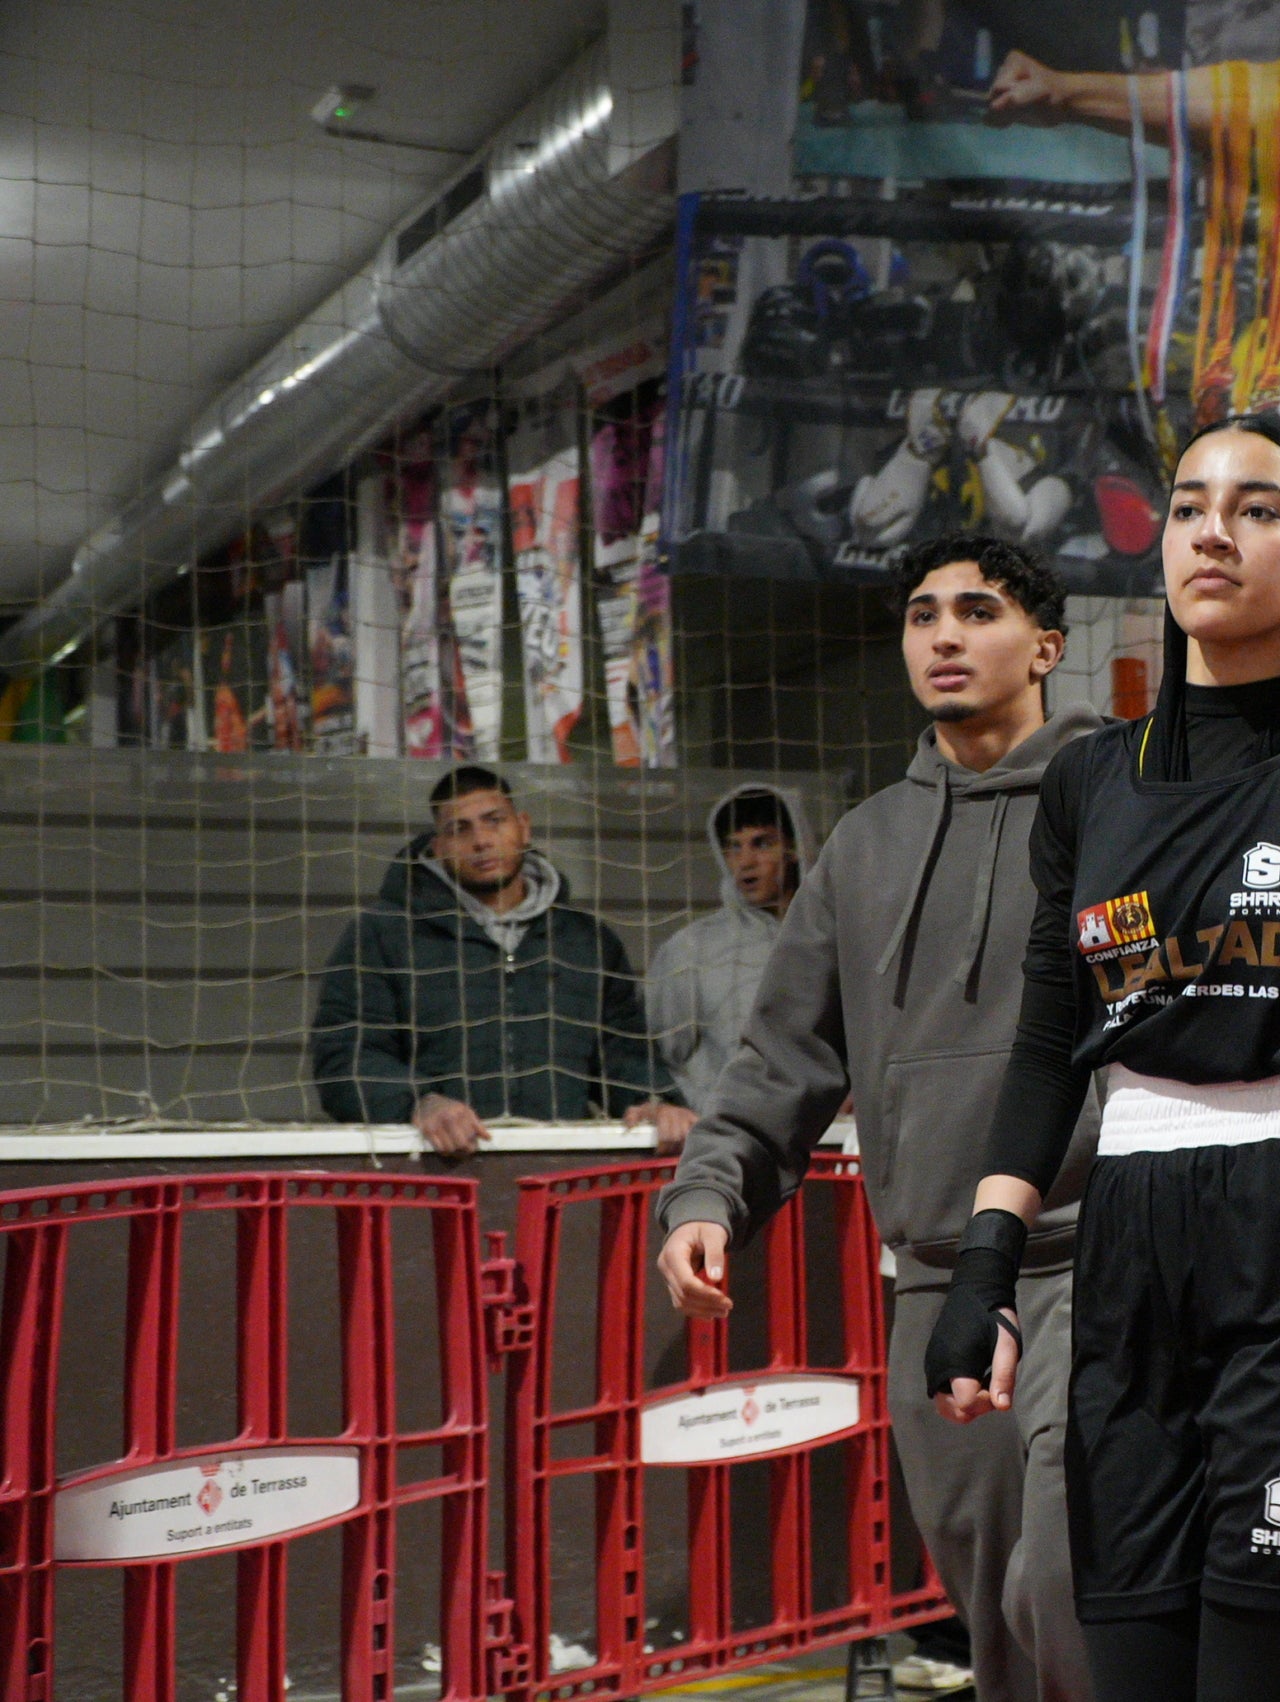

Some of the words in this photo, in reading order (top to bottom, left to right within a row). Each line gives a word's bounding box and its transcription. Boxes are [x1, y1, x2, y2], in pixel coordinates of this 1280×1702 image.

[1086, 938, 1160, 964] CONFIANZA
[1249, 985, 1280, 998] LAS
[108, 1493, 192, 1520] Ajuntament
[230, 1483, 247, 1498] de
[251, 1475, 308, 1495] Terrassa
[167, 1525, 203, 1542] Suport
[204, 1526, 213, 1535] a
[214, 1518, 253, 1534] entitats
